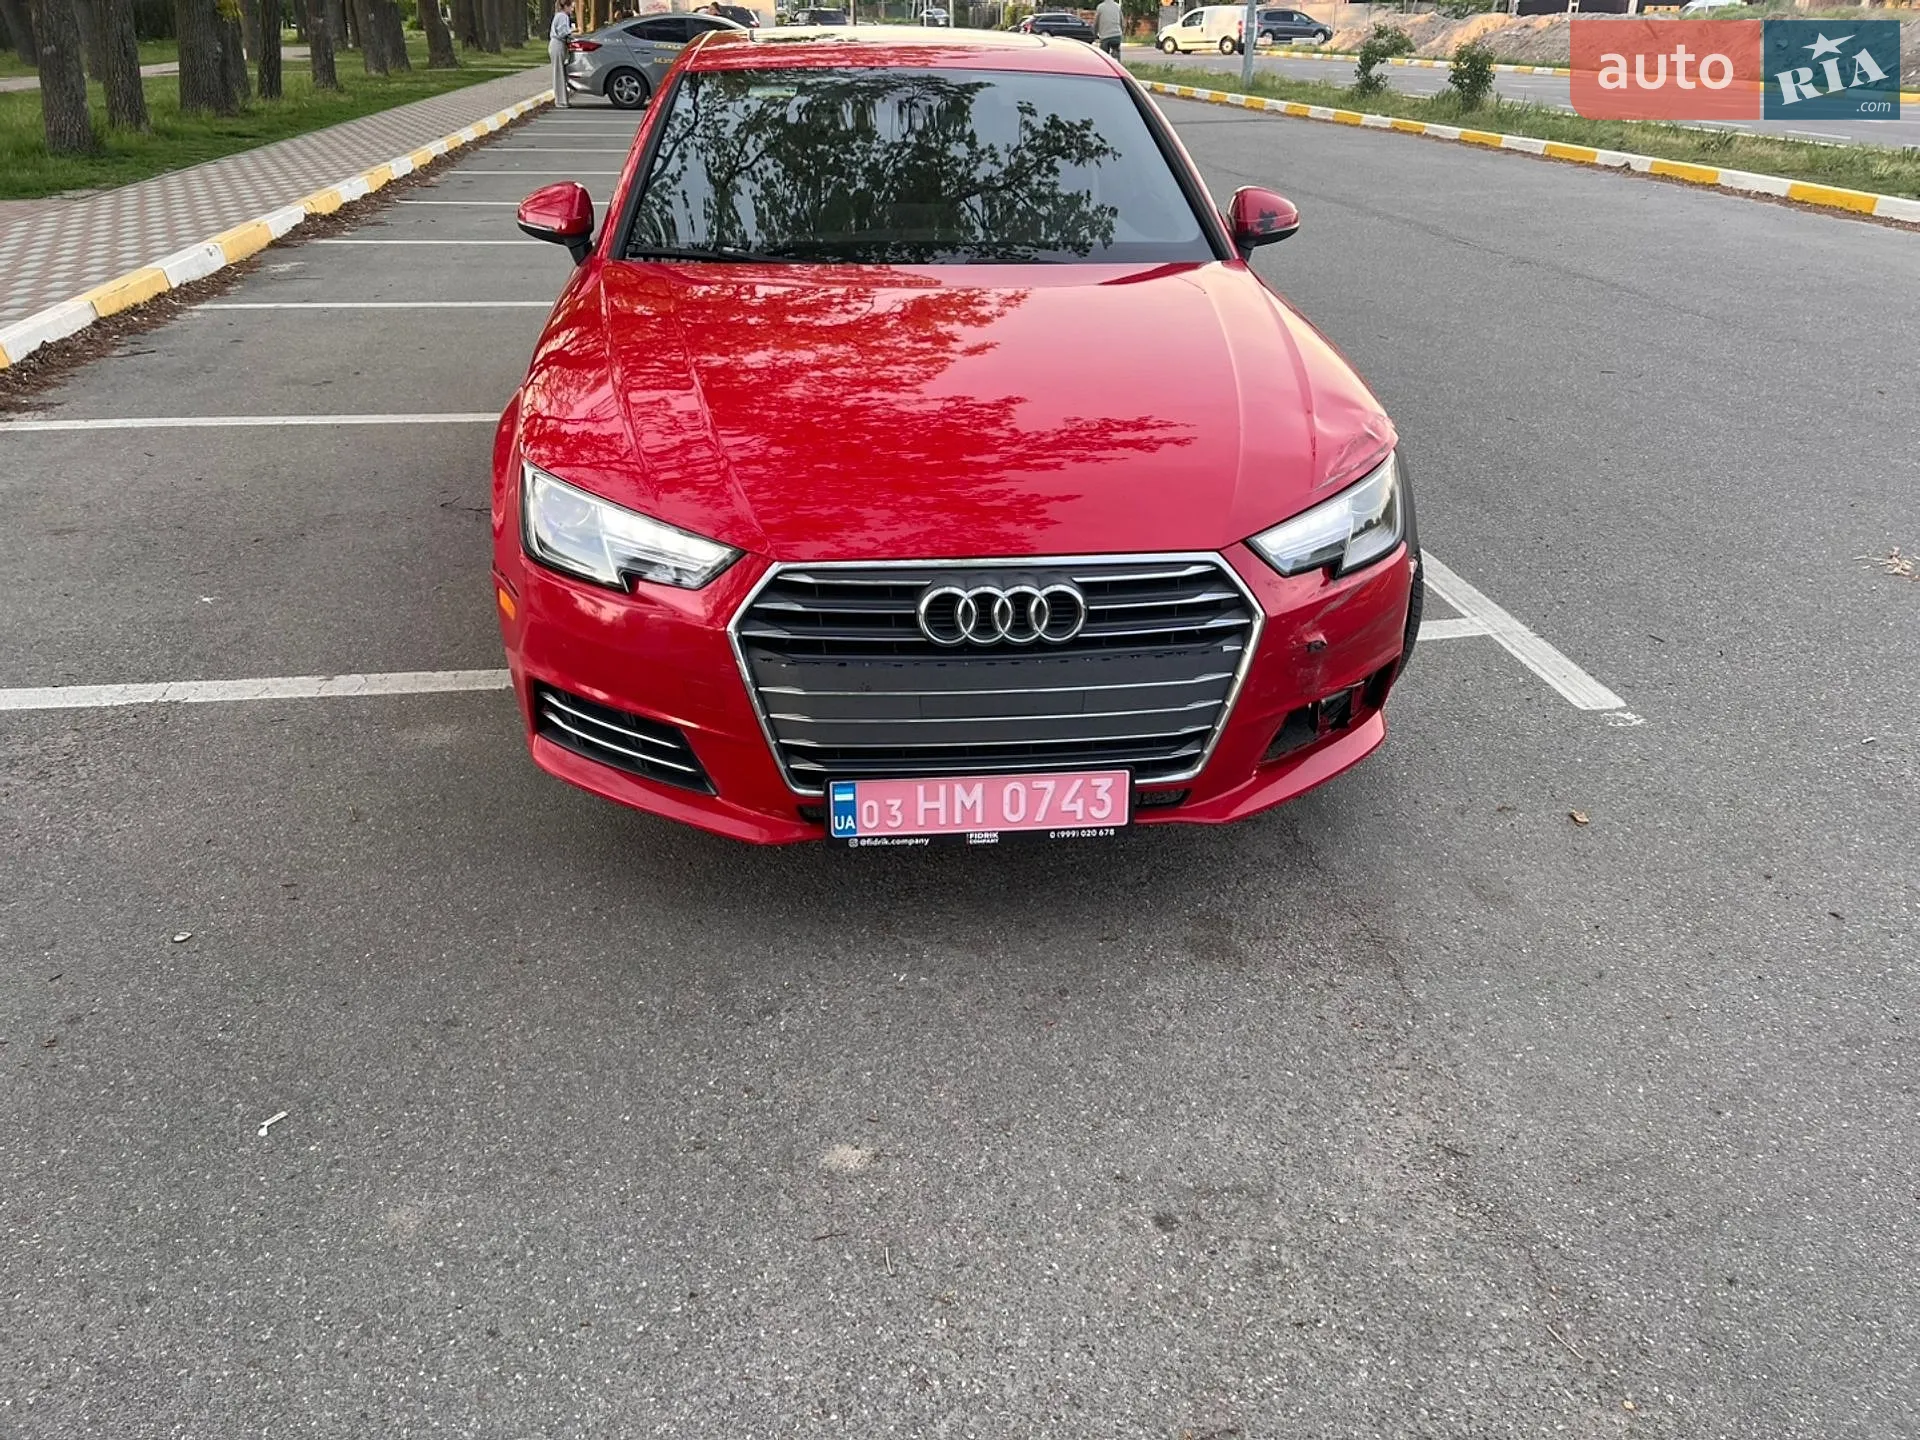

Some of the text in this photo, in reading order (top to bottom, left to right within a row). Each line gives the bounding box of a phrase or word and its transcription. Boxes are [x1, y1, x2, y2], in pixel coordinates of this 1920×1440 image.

[861, 778, 1114, 828] 03 HM 0743
[834, 816, 856, 830] UA
[1081, 829, 1097, 837] 020
[1099, 828, 1115, 836] 678
